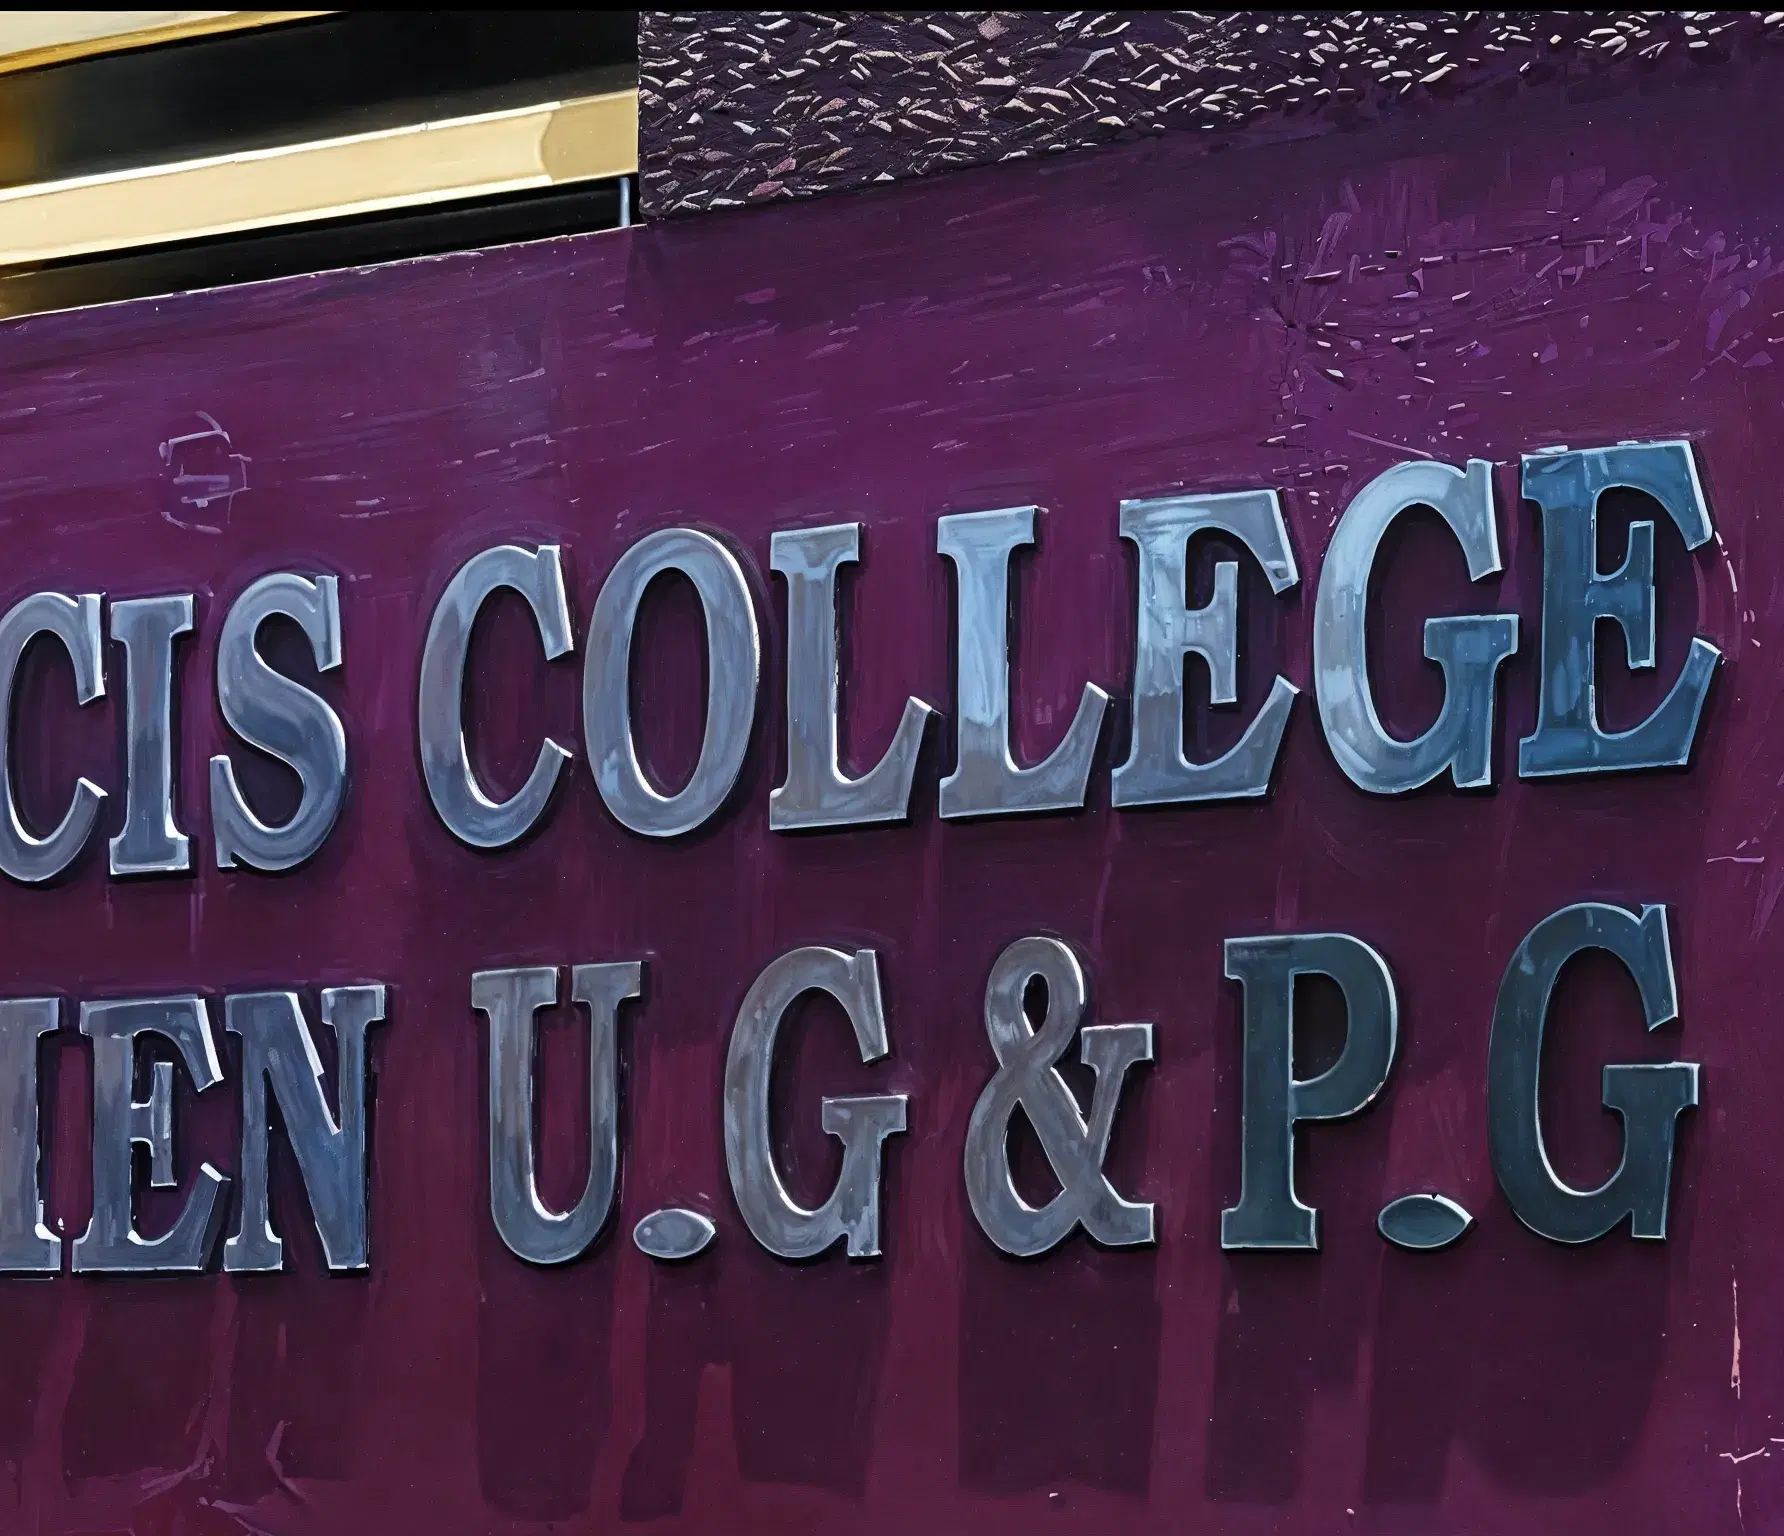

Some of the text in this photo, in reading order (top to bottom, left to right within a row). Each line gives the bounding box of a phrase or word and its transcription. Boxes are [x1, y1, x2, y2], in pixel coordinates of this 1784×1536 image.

[417, 438, 1725, 849] COLLEGE
[471, 943, 909, 1267] U.G
[964, 934, 1158, 1256] &
[1222, 899, 1701, 1253] P.G
